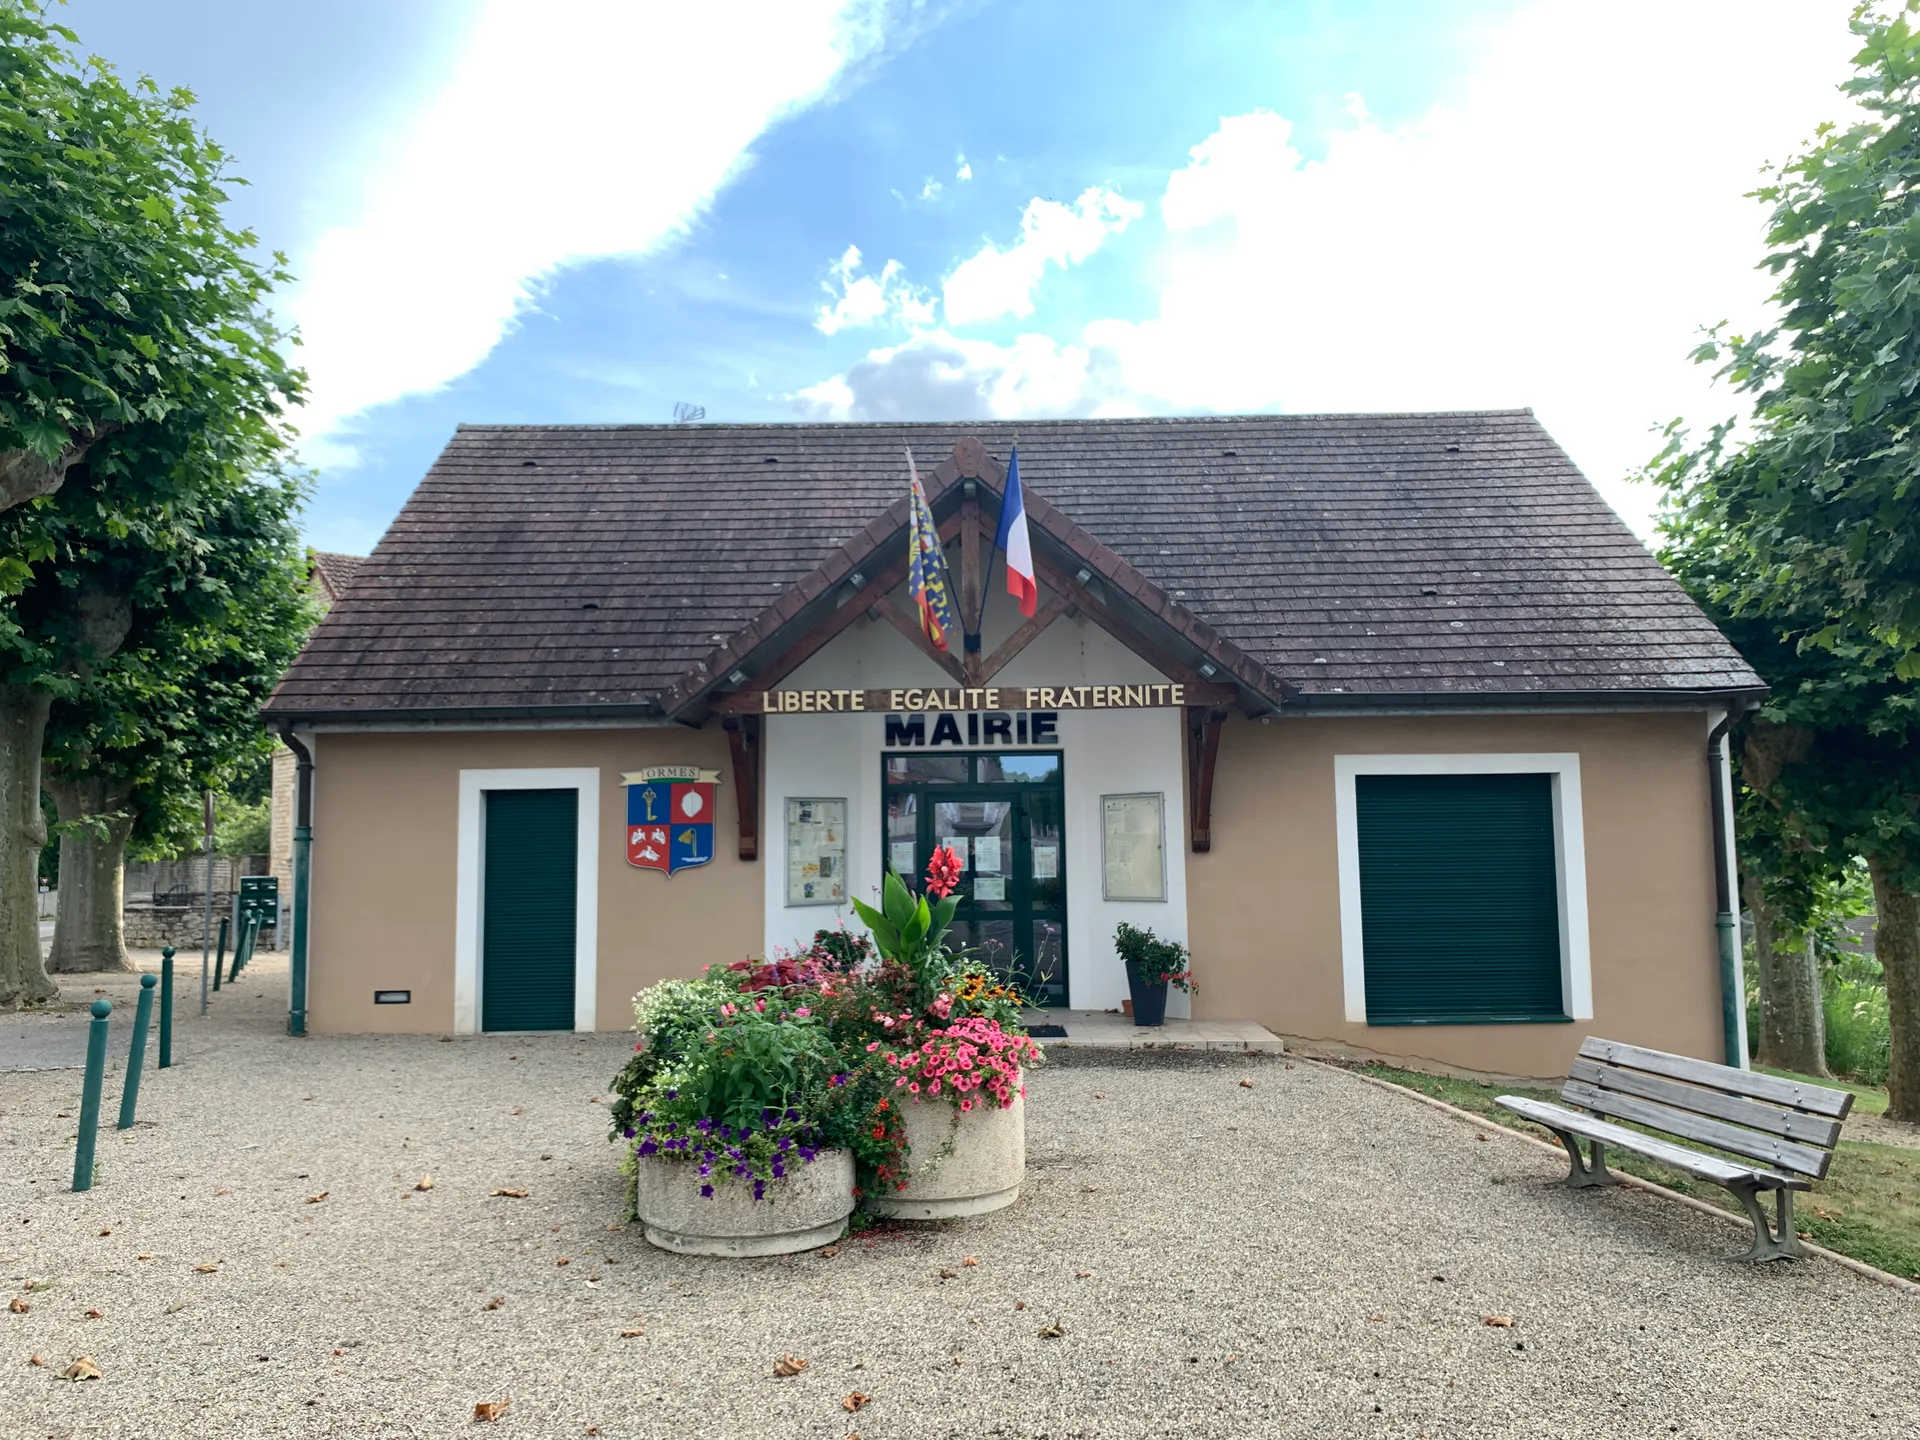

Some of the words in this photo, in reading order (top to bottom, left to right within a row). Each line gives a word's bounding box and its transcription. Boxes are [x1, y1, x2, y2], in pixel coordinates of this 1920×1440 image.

[763, 690, 865, 712] LIBERTE
[891, 688, 999, 710] EGALITE
[1026, 684, 1185, 709] FRATERNITE
[885, 712, 1059, 746] MAIRIE
[646, 767, 696, 778] ORMES
